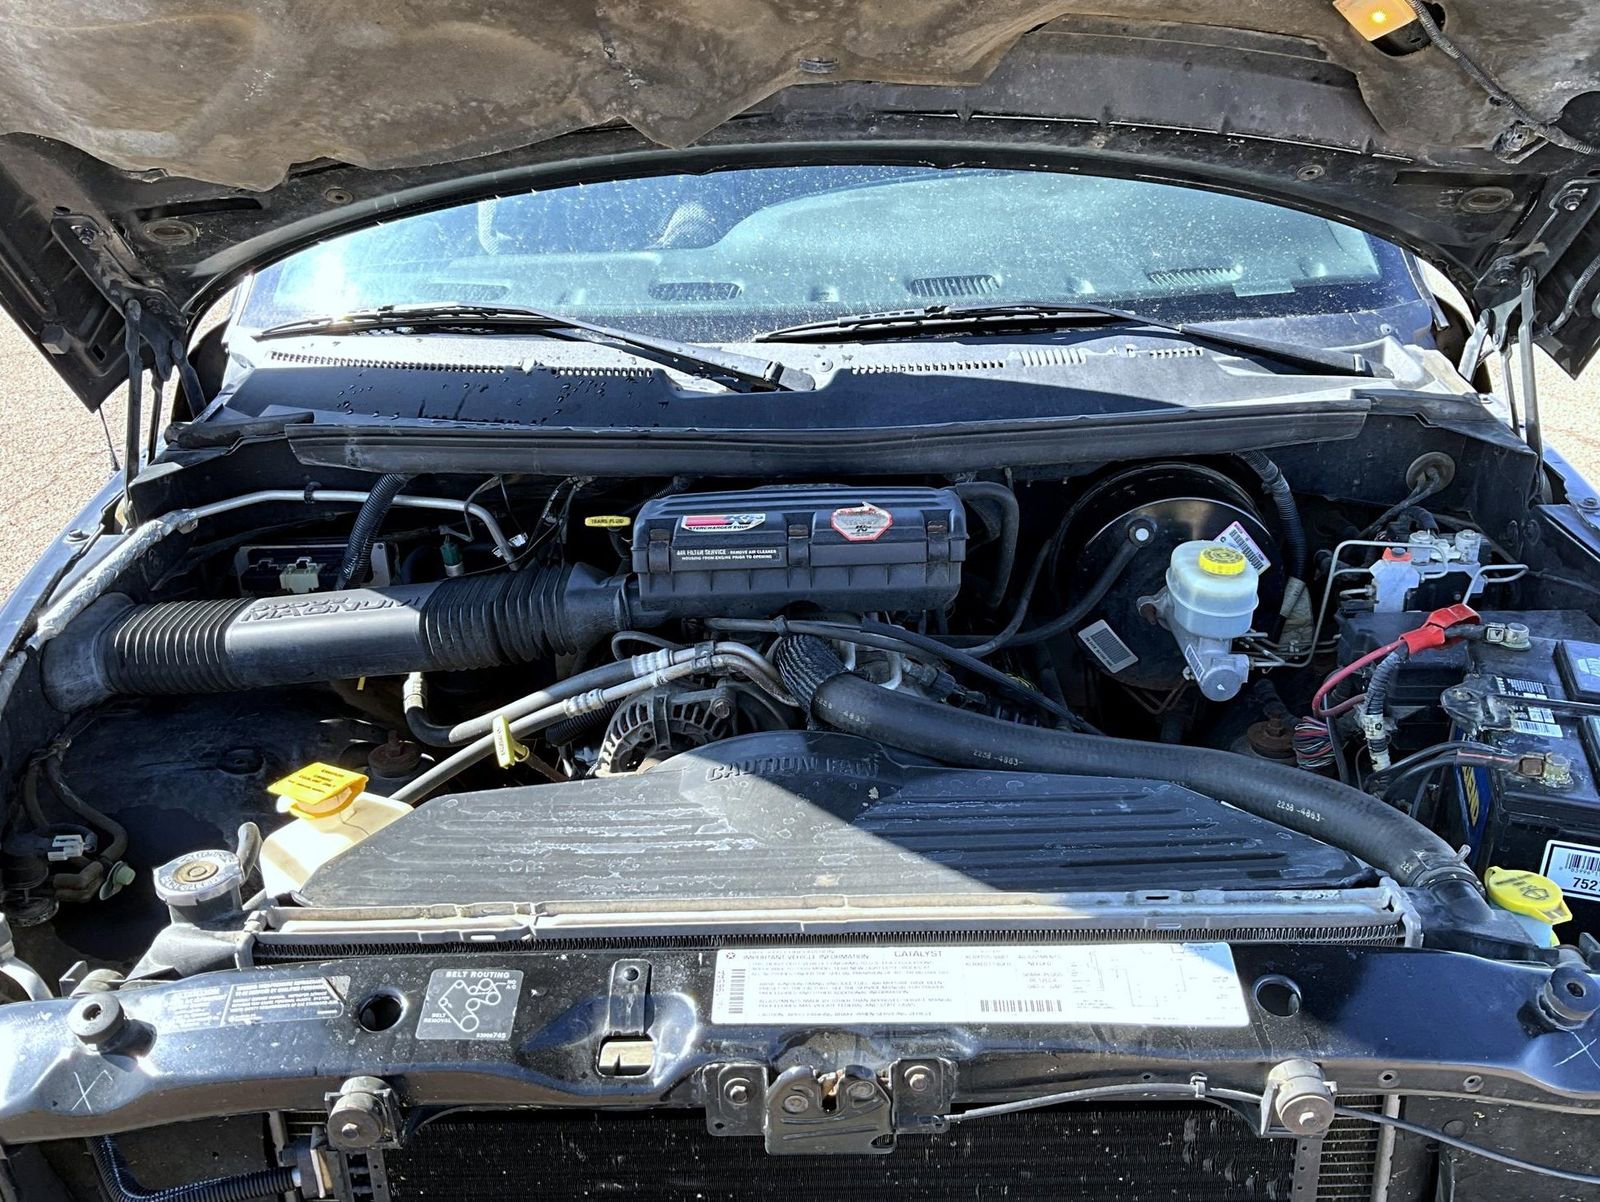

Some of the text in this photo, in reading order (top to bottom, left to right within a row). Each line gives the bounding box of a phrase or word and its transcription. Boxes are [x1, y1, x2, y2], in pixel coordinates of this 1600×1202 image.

[239, 596, 420, 621] MAGNUM
[707, 756, 818, 783] CAUTION
[1573, 876, 1600, 891] 752
[894, 950, 943, 958] CATALYST
[445, 970, 510, 979] BELT ROUTING
